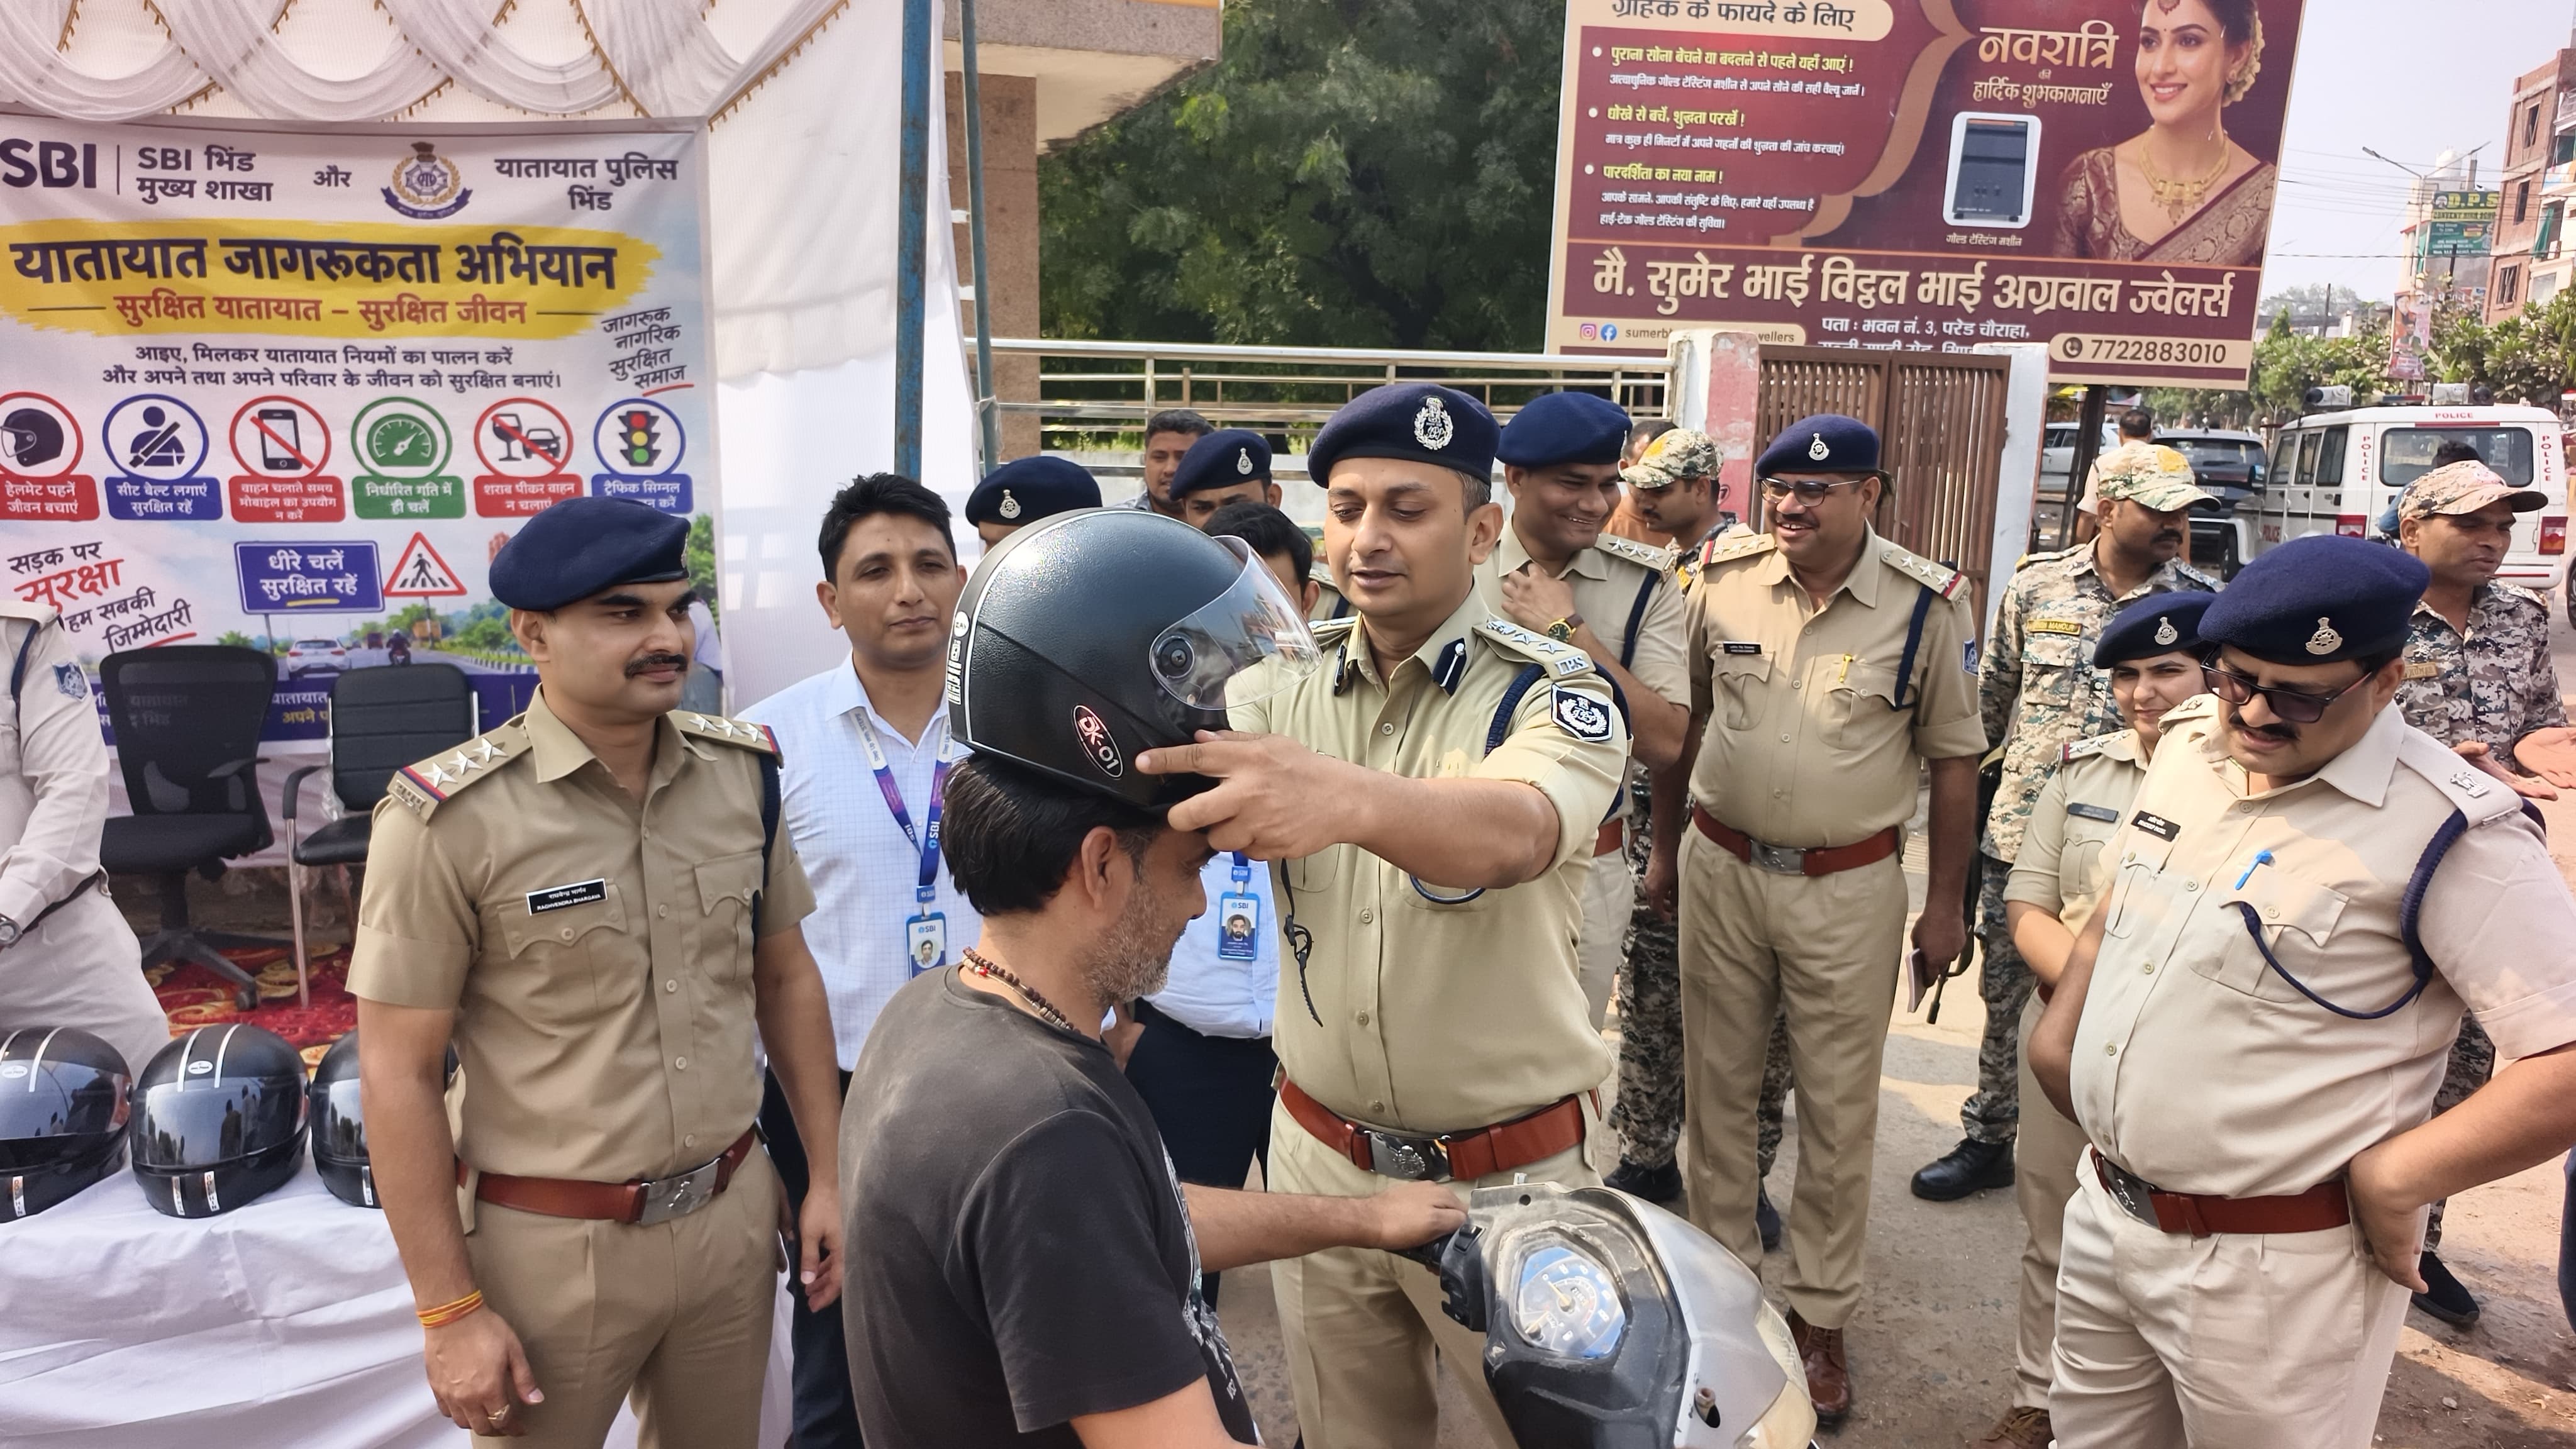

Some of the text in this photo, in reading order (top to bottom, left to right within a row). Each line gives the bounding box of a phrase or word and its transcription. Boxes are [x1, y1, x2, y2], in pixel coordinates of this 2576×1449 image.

[1718, 0, 1777, 23] फायदे
[1784, 2, 1807, 24] के
[1814, 3, 1855, 31] लिए
[1979, 20, 2119, 69] नवरात्रि
[1611, 45, 1847, 74] पुराना सोना बेचने या बदलने से पहले यहाँ आएं
[1658, 75, 1803, 93] गोल्ड टेस्टिंग मशीन से अपने सोने की
[2038, 69, 2051, 80] की
[1973, 76, 2113, 108] हार्दिक शुभकामनाएँ
[1607, 104, 1739, 130] धोखे से शुद्धता परखें
[1624, 133, 1792, 152] कुछ ही में अपने की की
[2, 138, 97, 189] SBI
[138, 145, 255, 172] SBI भिंड
[494, 152, 678, 186] यातायात पुलिस
[313, 165, 352, 187] और
[1604, 163, 1716, 183] पारदर्शिता का नया नाम
[137, 177, 273, 204] मुख्य शाखा
[568, 185, 612, 210] भिंड
[1601, 191, 1814, 212] आपके आपकी के हमारे है
[1635, 213, 1697, 228] गोल्ड की
[1946, 233, 2023, 246] गोल्ड मशीन
[10, 232, 617, 289] यातायात जागरूकता अभियान
[1594, 247, 1635, 296] मै.
[1646, 252, 1734, 314] सुमेर
[1742, 254, 1815, 308] भाई
[1917, 262, 1987, 313] भाई
[1993, 275, 2122, 315] अग्रवाल
[2129, 270, 2236, 318] ज्वेलर्स
[114, 287, 526, 331] सुरक्षित यातायात सुरक्षित जीवन
[601, 307, 671, 333] जागरूक
[614, 324, 681, 348] नागरिक
[1822, 316, 1975, 336] पता भवन नं. 3, परेड
[136, 343, 513, 365] आइए, मिलकर यातायात नियमों का पालन करें
[2091, 340, 2226, 364] 7722883010
[609, 348, 672, 381] सुरक्षित
[103, 365, 136, 384] और
[145, 366, 186, 384] अपने
[192, 370, 225, 386] तथा
[233, 368, 275, 386] अपने
[282, 368, 337, 387] परिवार
[343, 369, 361, 387] के
[366, 370, 413, 387] जीवन
[421, 369, 441, 387] को
[448, 370, 506, 393] सुरक्षित
[633, 365, 687, 389] समाज
[2361, 436, 2370, 481] POLICE
[2541, 435, 2551, 482] POLICE
[5, 480, 75, 497] हेलमेट पहनें
[117, 483, 140, 497] सीट
[145, 484, 169, 497] बेल्ट
[242, 481, 333, 493] वाहन चलाते समय
[365, 481, 452, 497] निर्धारित गति में
[483, 482, 575, 495] शराब पीकर वाहन
[604, 479, 680, 496] ट्रैफिक सिग्नल
[7, 499, 41, 514] जीवन
[131, 499, 193, 516] सुरक्षित रहें
[283, 497, 298, 508] का
[391, 499, 430, 514] ही चलें
[506, 501, 515, 511] न
[659, 494, 677, 508] करें
[8, 541, 103, 574] सड़क पर
[268, 549, 344, 571] धीरे चलें
[14, 558, 125, 614] सुरक्षा
[260, 573, 358, 601] सुरक्षित रहें
[65, 586, 156, 633] हम सबकी
[103, 598, 191, 653] जिम्मेदारी
[1555, 655, 1589, 675] IPS
[930, 821, 940, 838] SBI
[536, 894, 601, 911] RAGHVENDRA BHARGAVA
